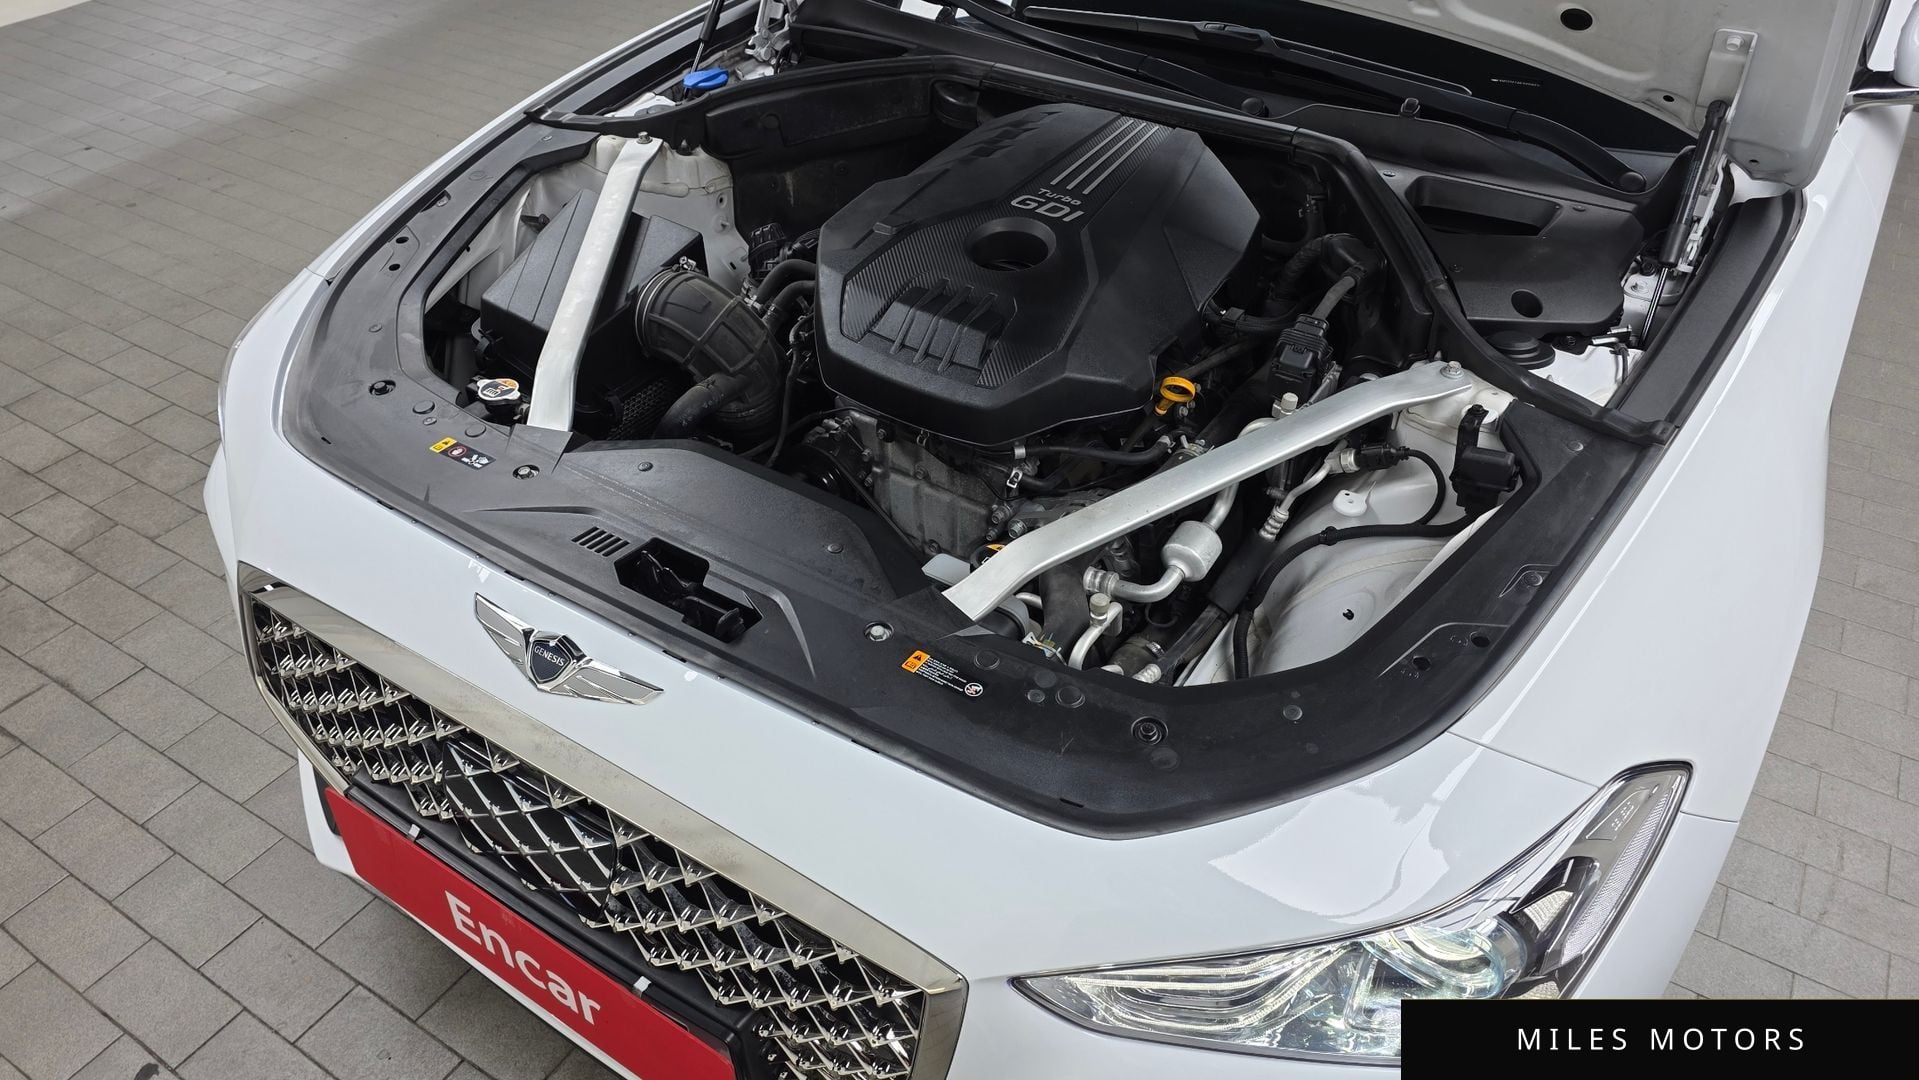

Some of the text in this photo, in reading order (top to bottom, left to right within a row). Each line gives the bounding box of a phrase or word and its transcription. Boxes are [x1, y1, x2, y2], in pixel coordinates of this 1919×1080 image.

[1010, 194, 1085, 222] GDI
[1038, 187, 1082, 206] Turbo
[534, 645, 565, 667] GENESIS
[444, 890, 601, 1026] Encar
